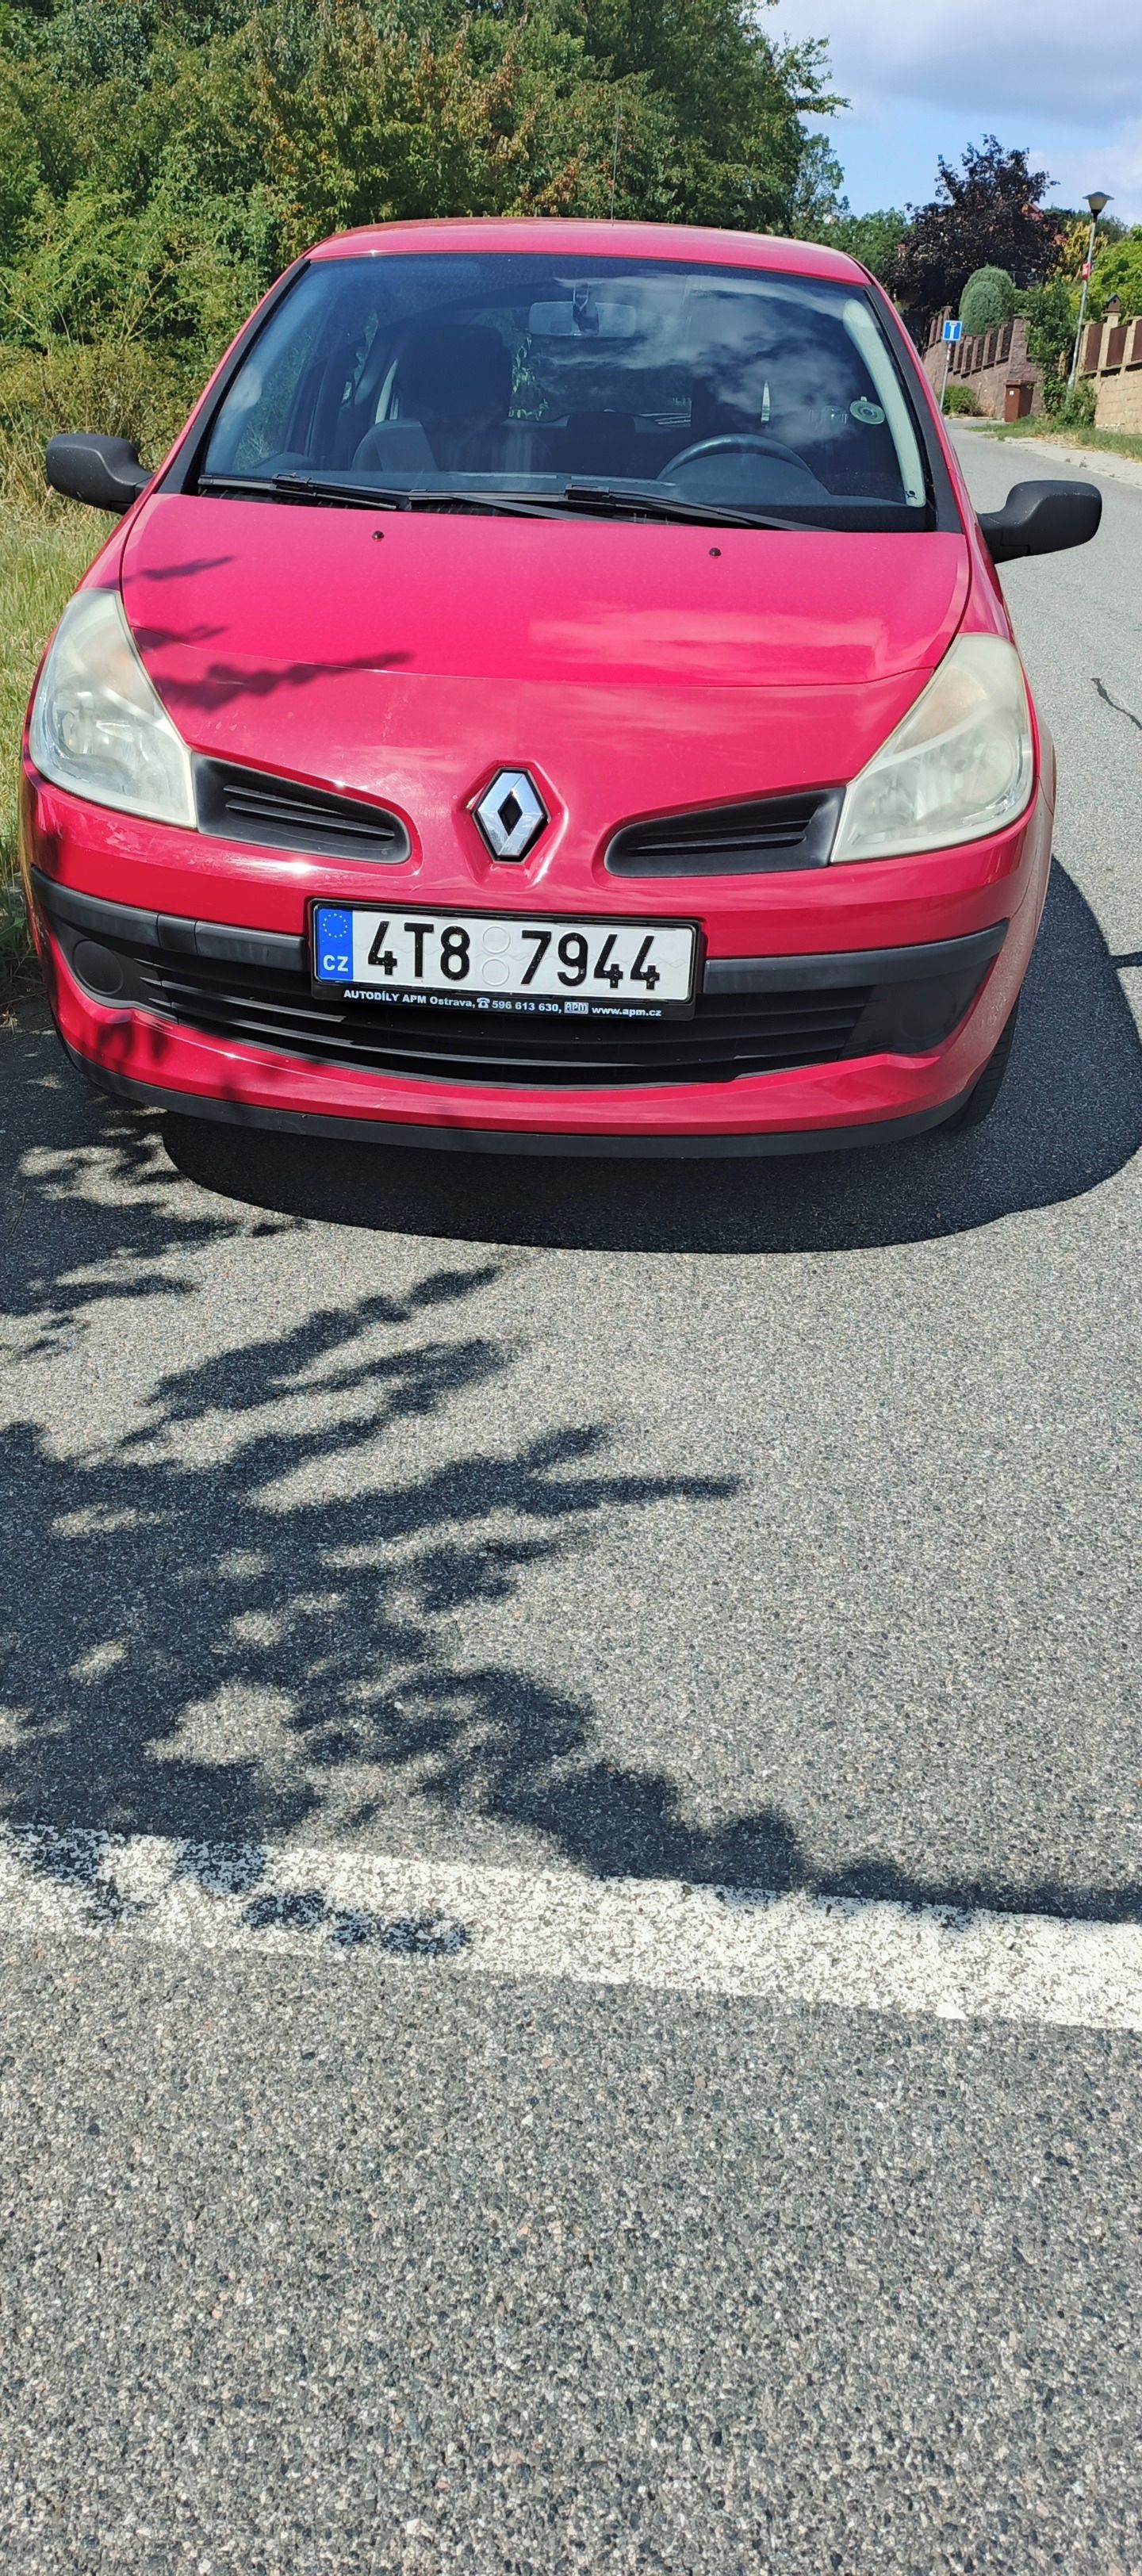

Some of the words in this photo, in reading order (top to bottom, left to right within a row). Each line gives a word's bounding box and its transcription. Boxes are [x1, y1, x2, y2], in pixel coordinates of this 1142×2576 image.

[323, 954, 349, 972] CZ
[367, 920, 471, 981] 4T8
[519, 930, 661, 991] 7944
[343, 989, 400, 1002] AUTODÍLY
[402, 994, 427, 1004] APM
[429, 996, 476, 1009] Ostrava,
[492, 1000, 512, 1010] 596
[515, 1002, 535, 1011] 613
[538, 1002, 562, 1014] 630,
[592, 1006, 662, 1018] www.apm.cz
